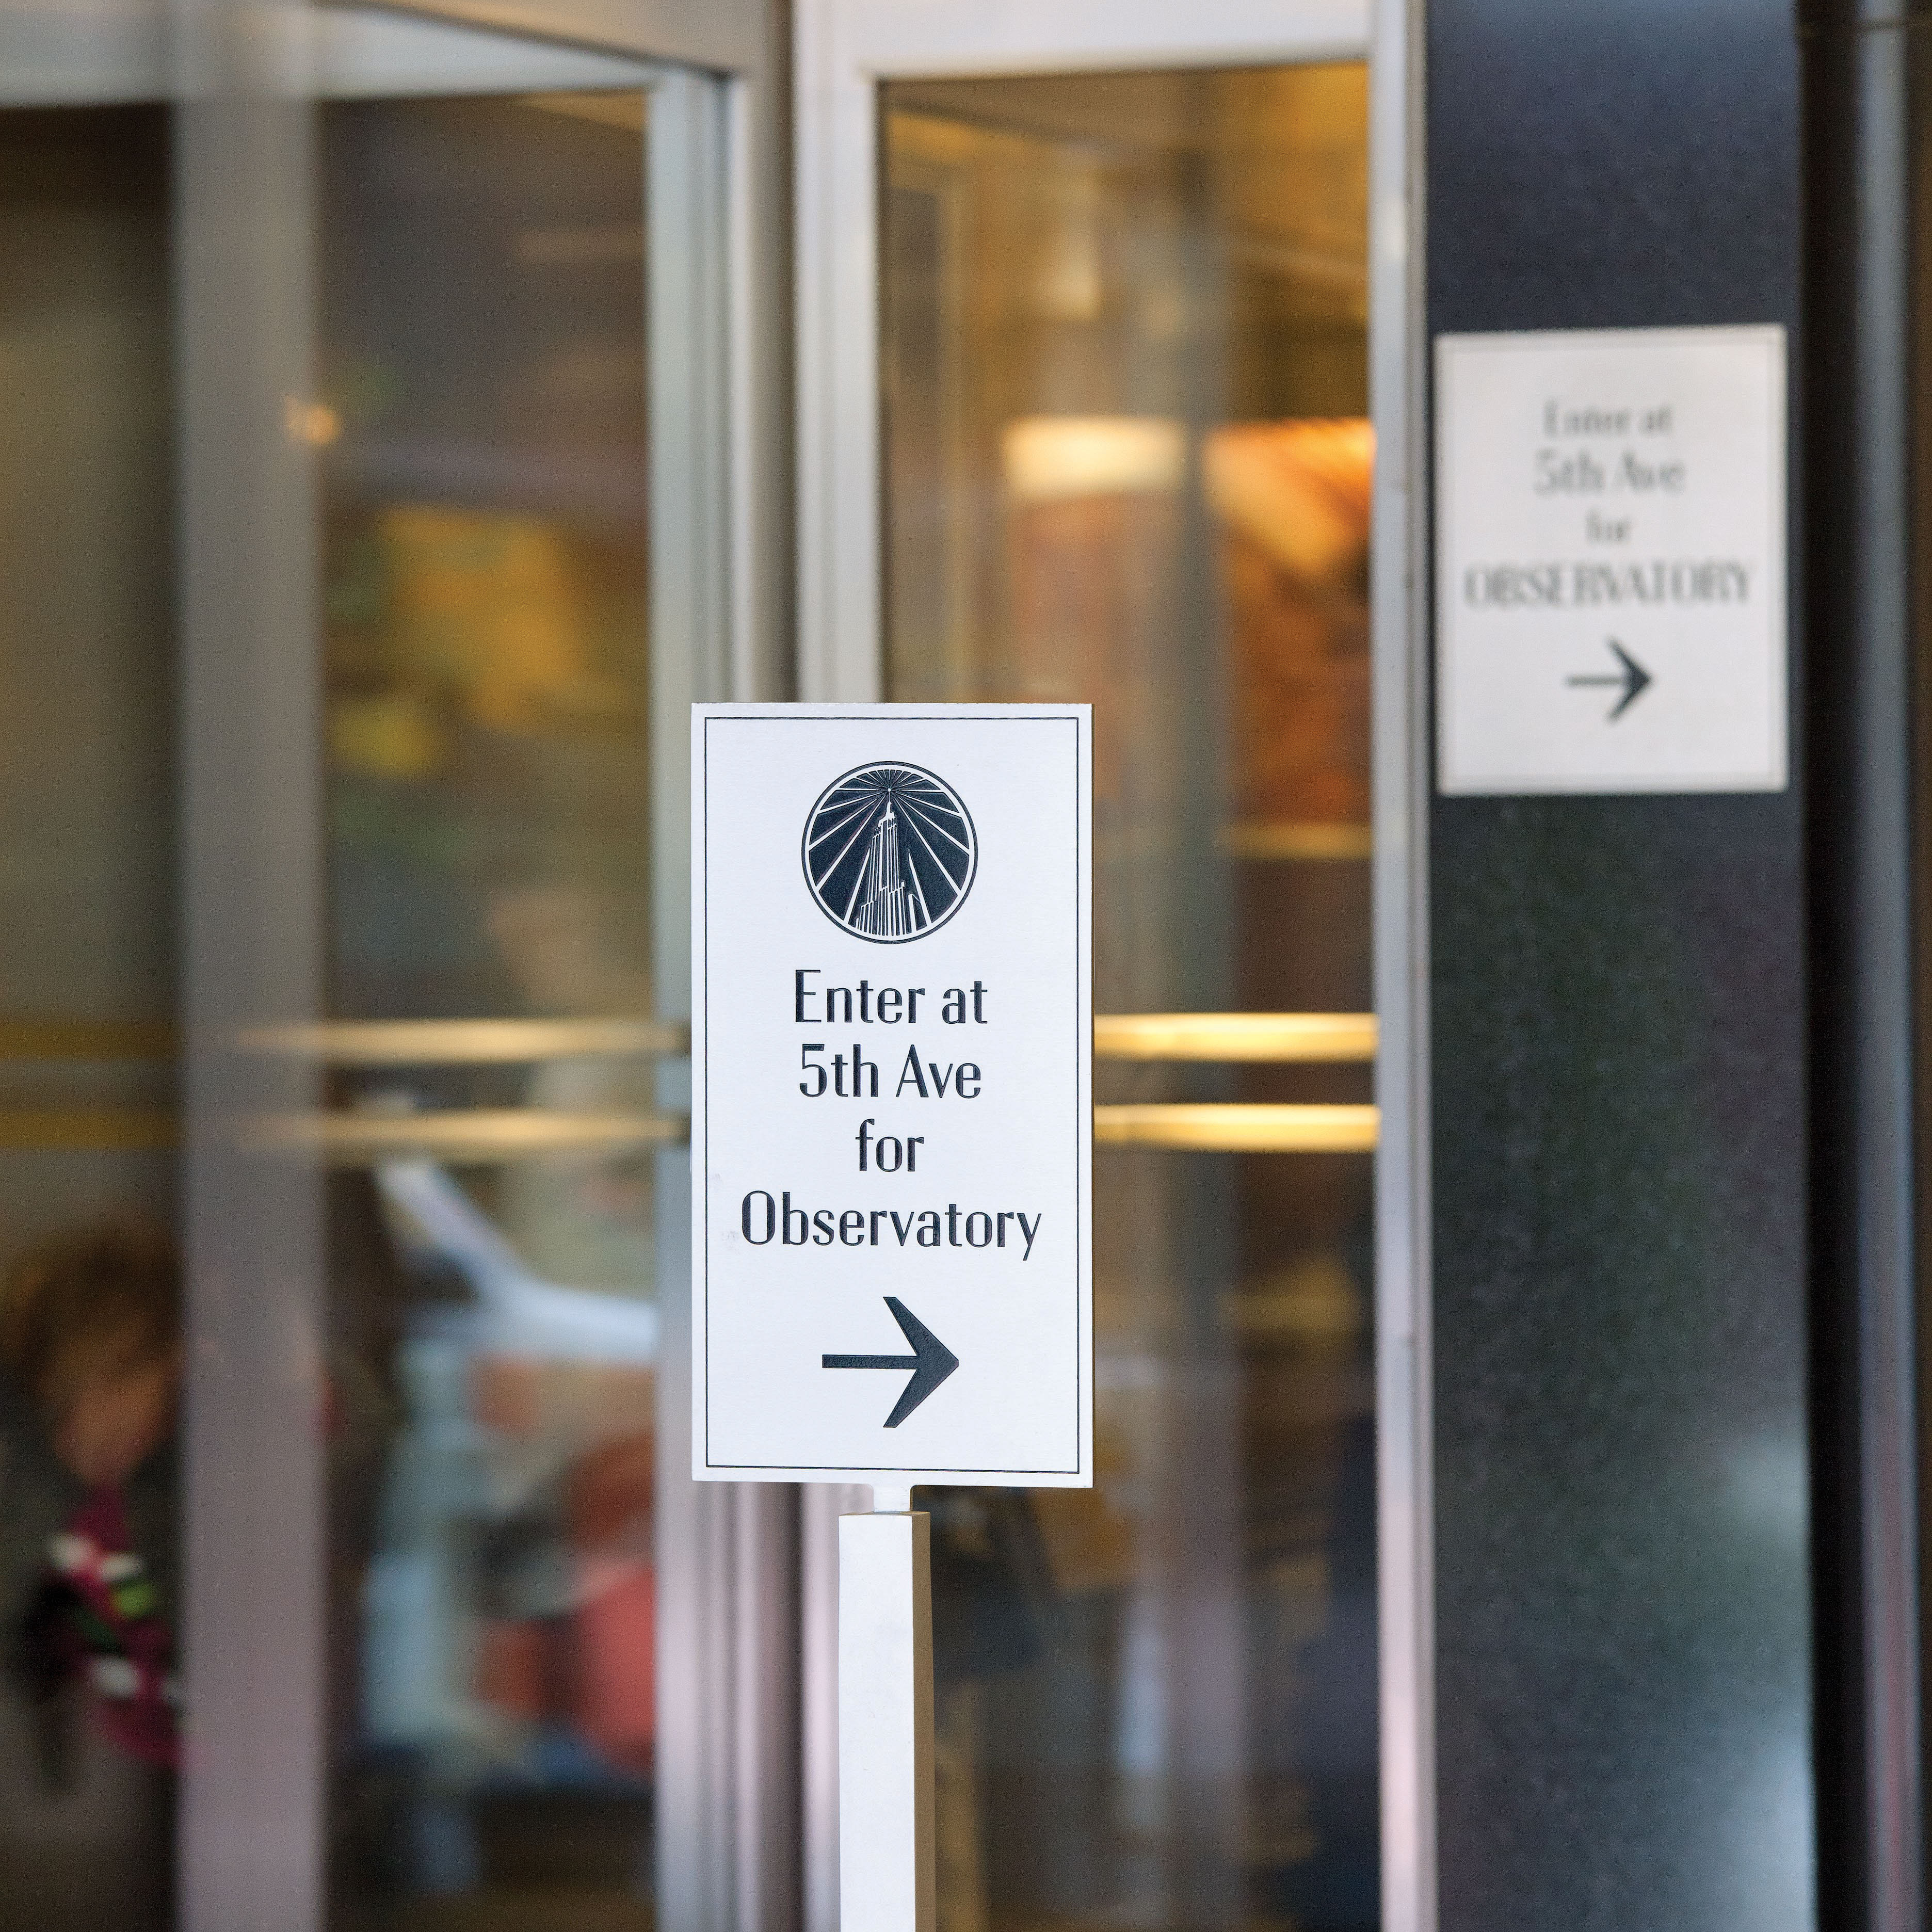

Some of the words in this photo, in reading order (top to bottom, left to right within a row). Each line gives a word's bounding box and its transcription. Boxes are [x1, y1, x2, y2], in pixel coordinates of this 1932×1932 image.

[1543, 400, 1631, 437] Enter
[1640, 405, 1672, 435] at
[1535, 449, 1605, 496] 5th
[1611, 450, 1685, 494] Ave
[1586, 509, 1631, 543] for
[1464, 561, 1749, 607] OBSERVATORY
[795, 969, 926, 1024] Enter
[942, 980, 988, 1024] at
[799, 1043, 879, 1098] 5th
[895, 1044, 981, 1099] Ave
[855, 1118, 924, 1172] for
[742, 1190, 1042, 1261] Observatory
